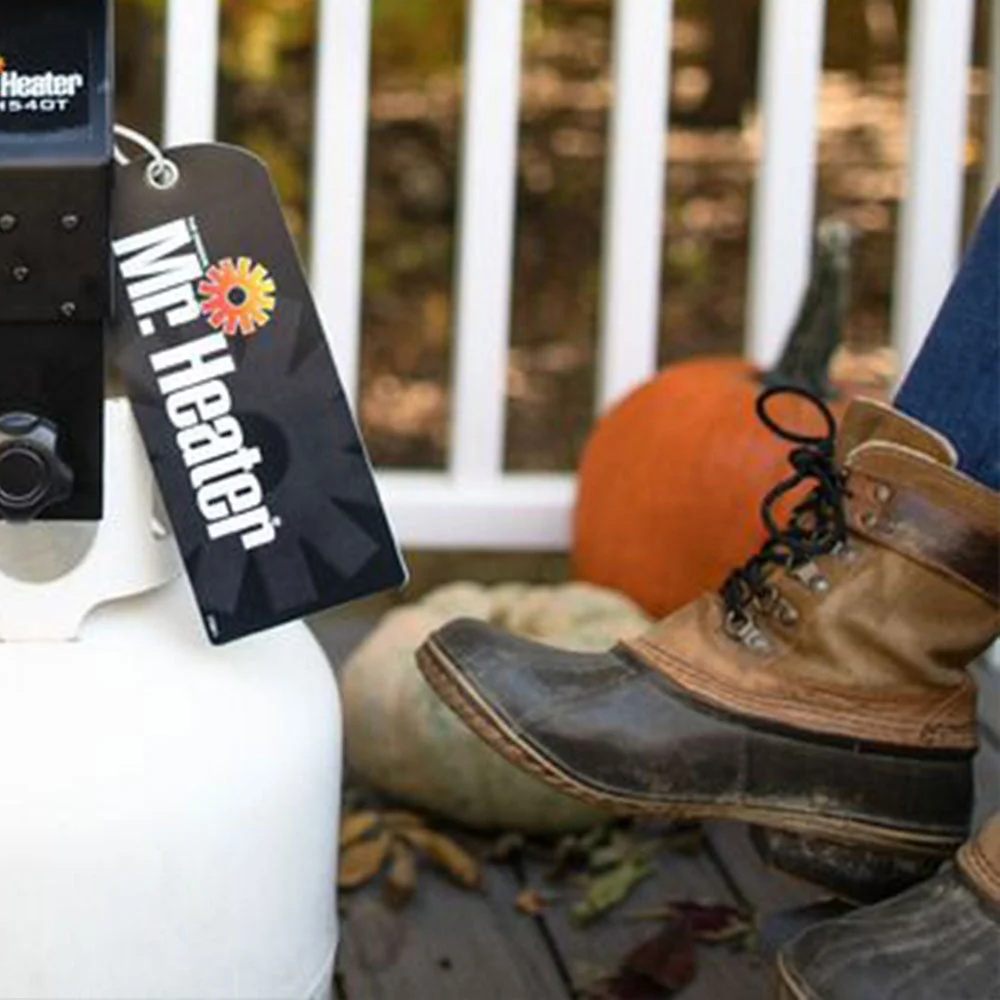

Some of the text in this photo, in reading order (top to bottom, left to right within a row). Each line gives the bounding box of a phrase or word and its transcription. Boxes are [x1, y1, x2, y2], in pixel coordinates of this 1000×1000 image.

[0, 70, 84, 97] Heater
[112, 218, 277, 551] Mr. Heater
